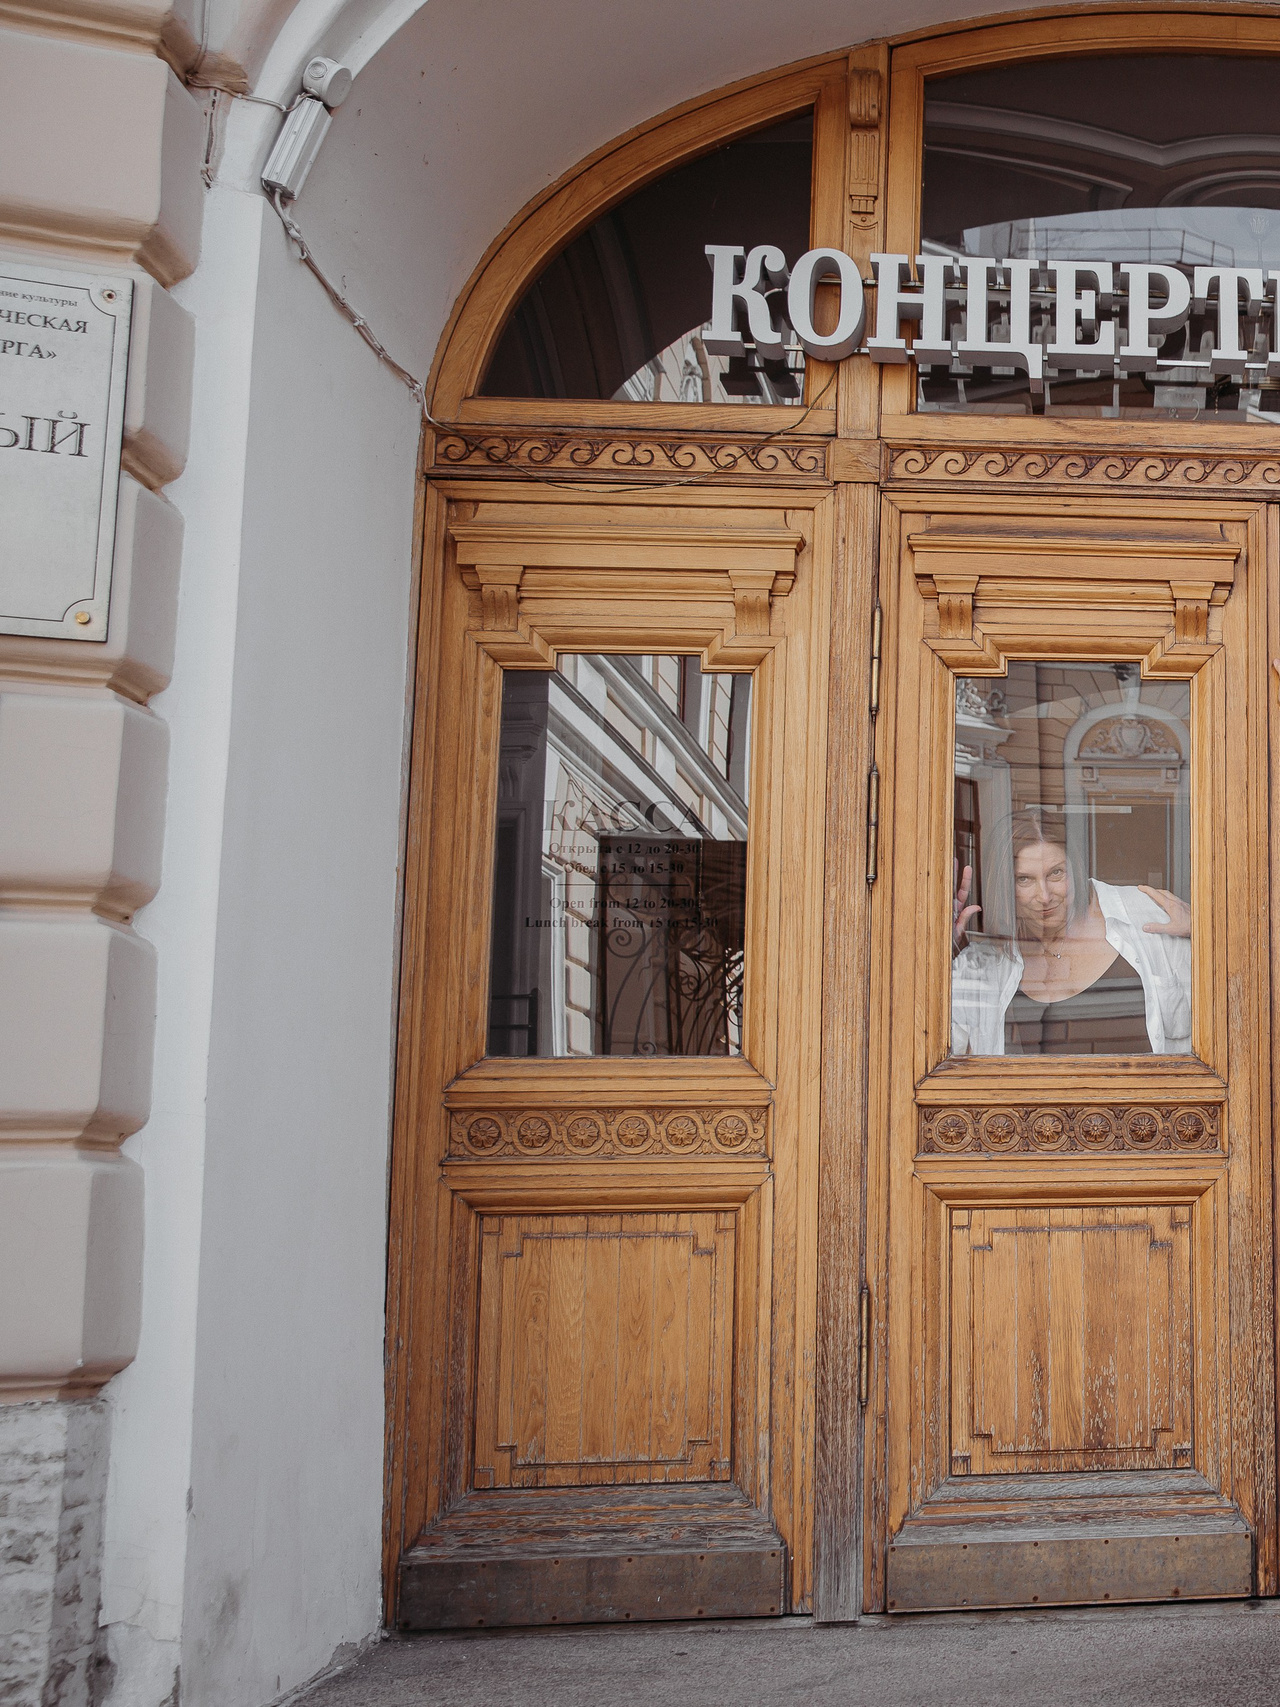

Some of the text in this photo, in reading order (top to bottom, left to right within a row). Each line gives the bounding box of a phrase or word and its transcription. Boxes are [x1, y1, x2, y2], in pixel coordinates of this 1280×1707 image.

[22, 293, 78, 307] культуры
[543, 799, 708, 832] КАССА
[549, 842, 612, 857] Открыта
[628, 843, 641, 854] 12
[645, 845, 660, 855] до
[665, 843, 699, 855] 20-30
[564, 862, 597, 875] Обед
[612, 863, 626, 874] 15
[629, 865, 645, 875] до
[650, 863, 684, 874] 15-30
[549, 898, 585, 912] Open
[589, 898, 620, 909] from
[625, 898, 639, 909] 12
[644, 898, 656, 909] to
[525, 917, 567, 928] Lunch
[571, 917, 608, 928] break
[613, 917, 644, 928] from
[649, 917, 663, 928] 15
[667, 917, 680, 928] to
